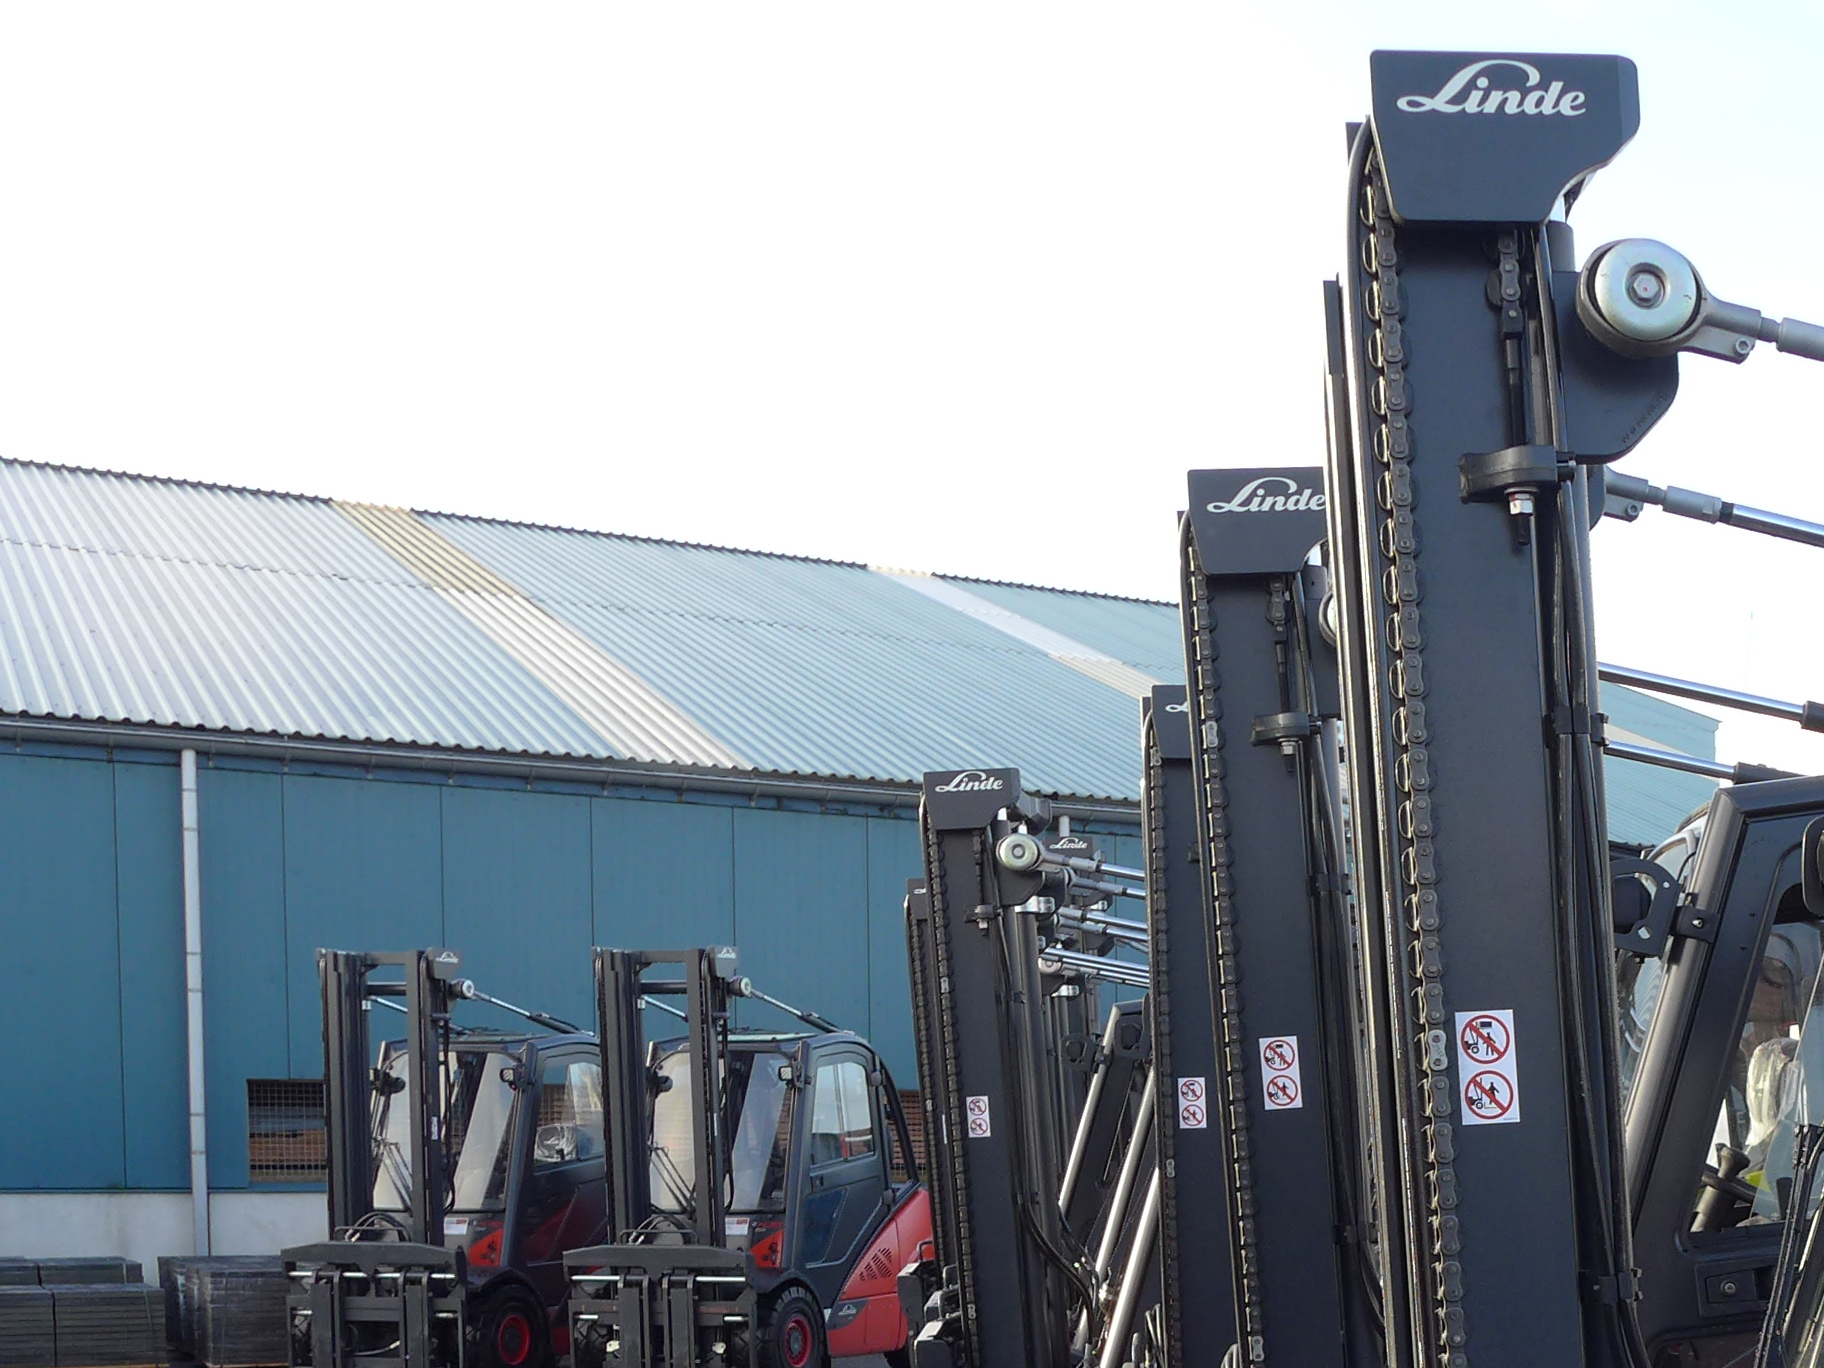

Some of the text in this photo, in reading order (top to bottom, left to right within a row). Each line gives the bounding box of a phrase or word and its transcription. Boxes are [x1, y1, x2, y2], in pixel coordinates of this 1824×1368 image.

[1396, 59, 1586, 116] Linde
[1206, 476, 1326, 513] Linde
[935, 770, 1003, 793] Linde
